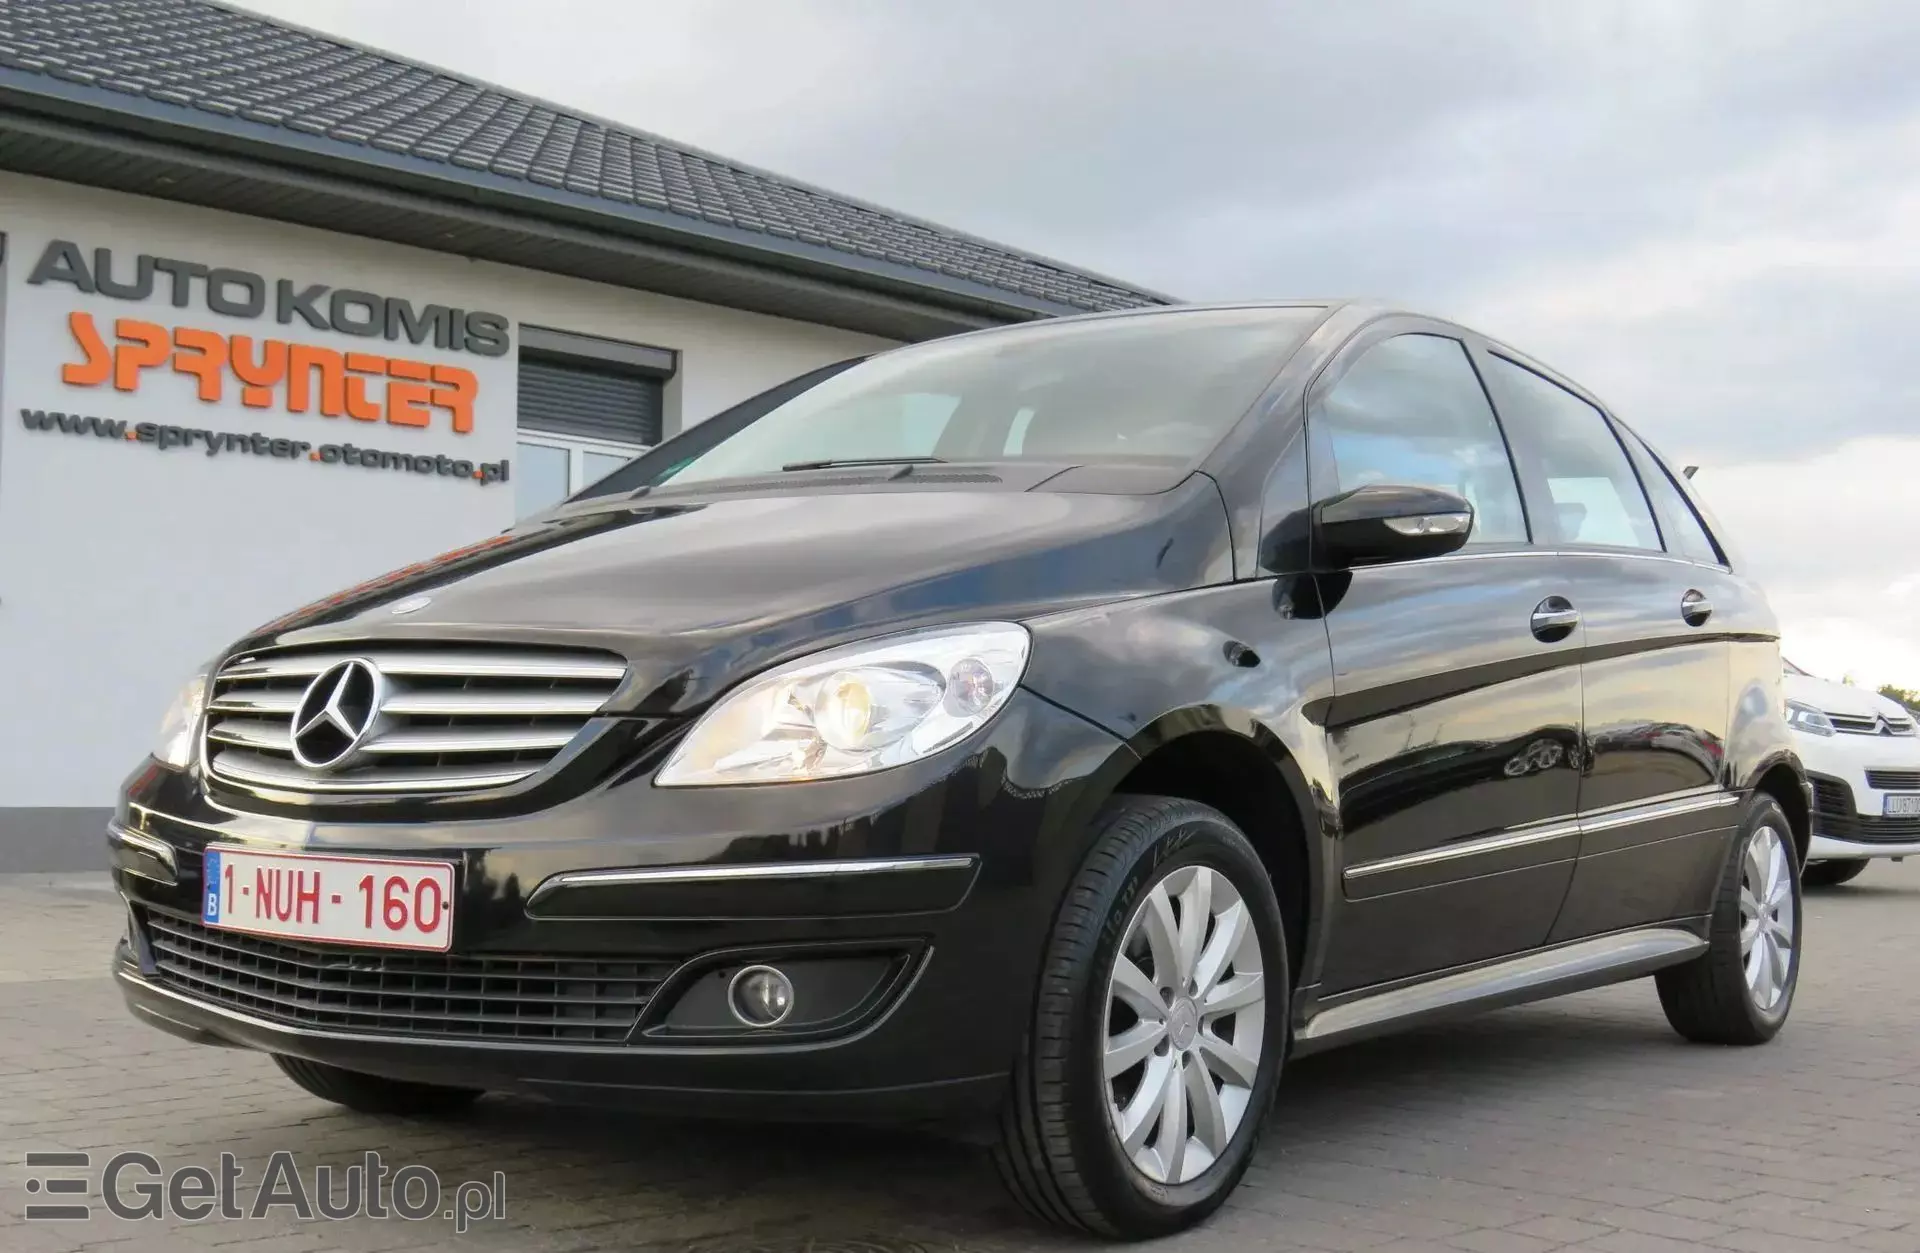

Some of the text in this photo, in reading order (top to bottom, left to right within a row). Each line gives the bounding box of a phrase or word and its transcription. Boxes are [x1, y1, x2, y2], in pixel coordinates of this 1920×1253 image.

[27, 239, 509, 357] AUTO KOMIS
[62, 311, 479, 433] SPRYNTER
[20, 408, 510, 485] www.sprynter.otomoto.pl
[207, 893, 217, 917] B
